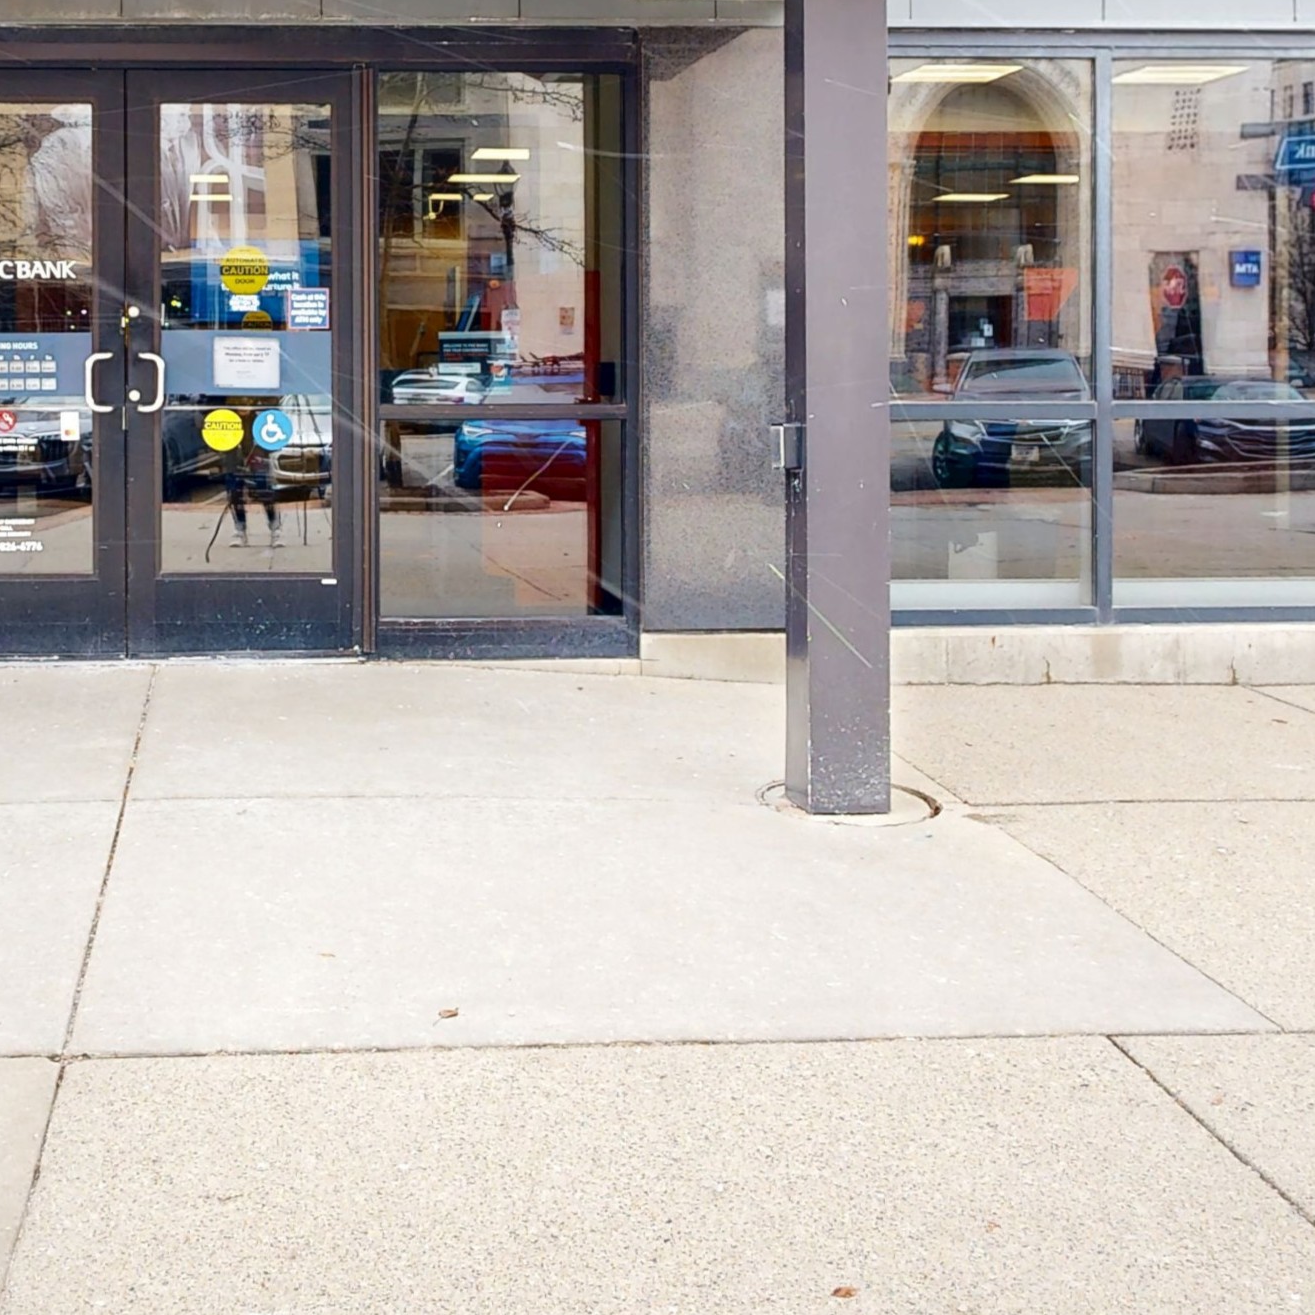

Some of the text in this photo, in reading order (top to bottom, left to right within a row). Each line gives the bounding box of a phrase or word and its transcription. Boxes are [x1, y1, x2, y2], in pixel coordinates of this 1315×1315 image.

[15, 260, 77, 279] BANK
[222, 266, 268, 275] CAUTION
[12, 342, 38, 350] HOURS
[204, 422, 242, 430] CAUTION
